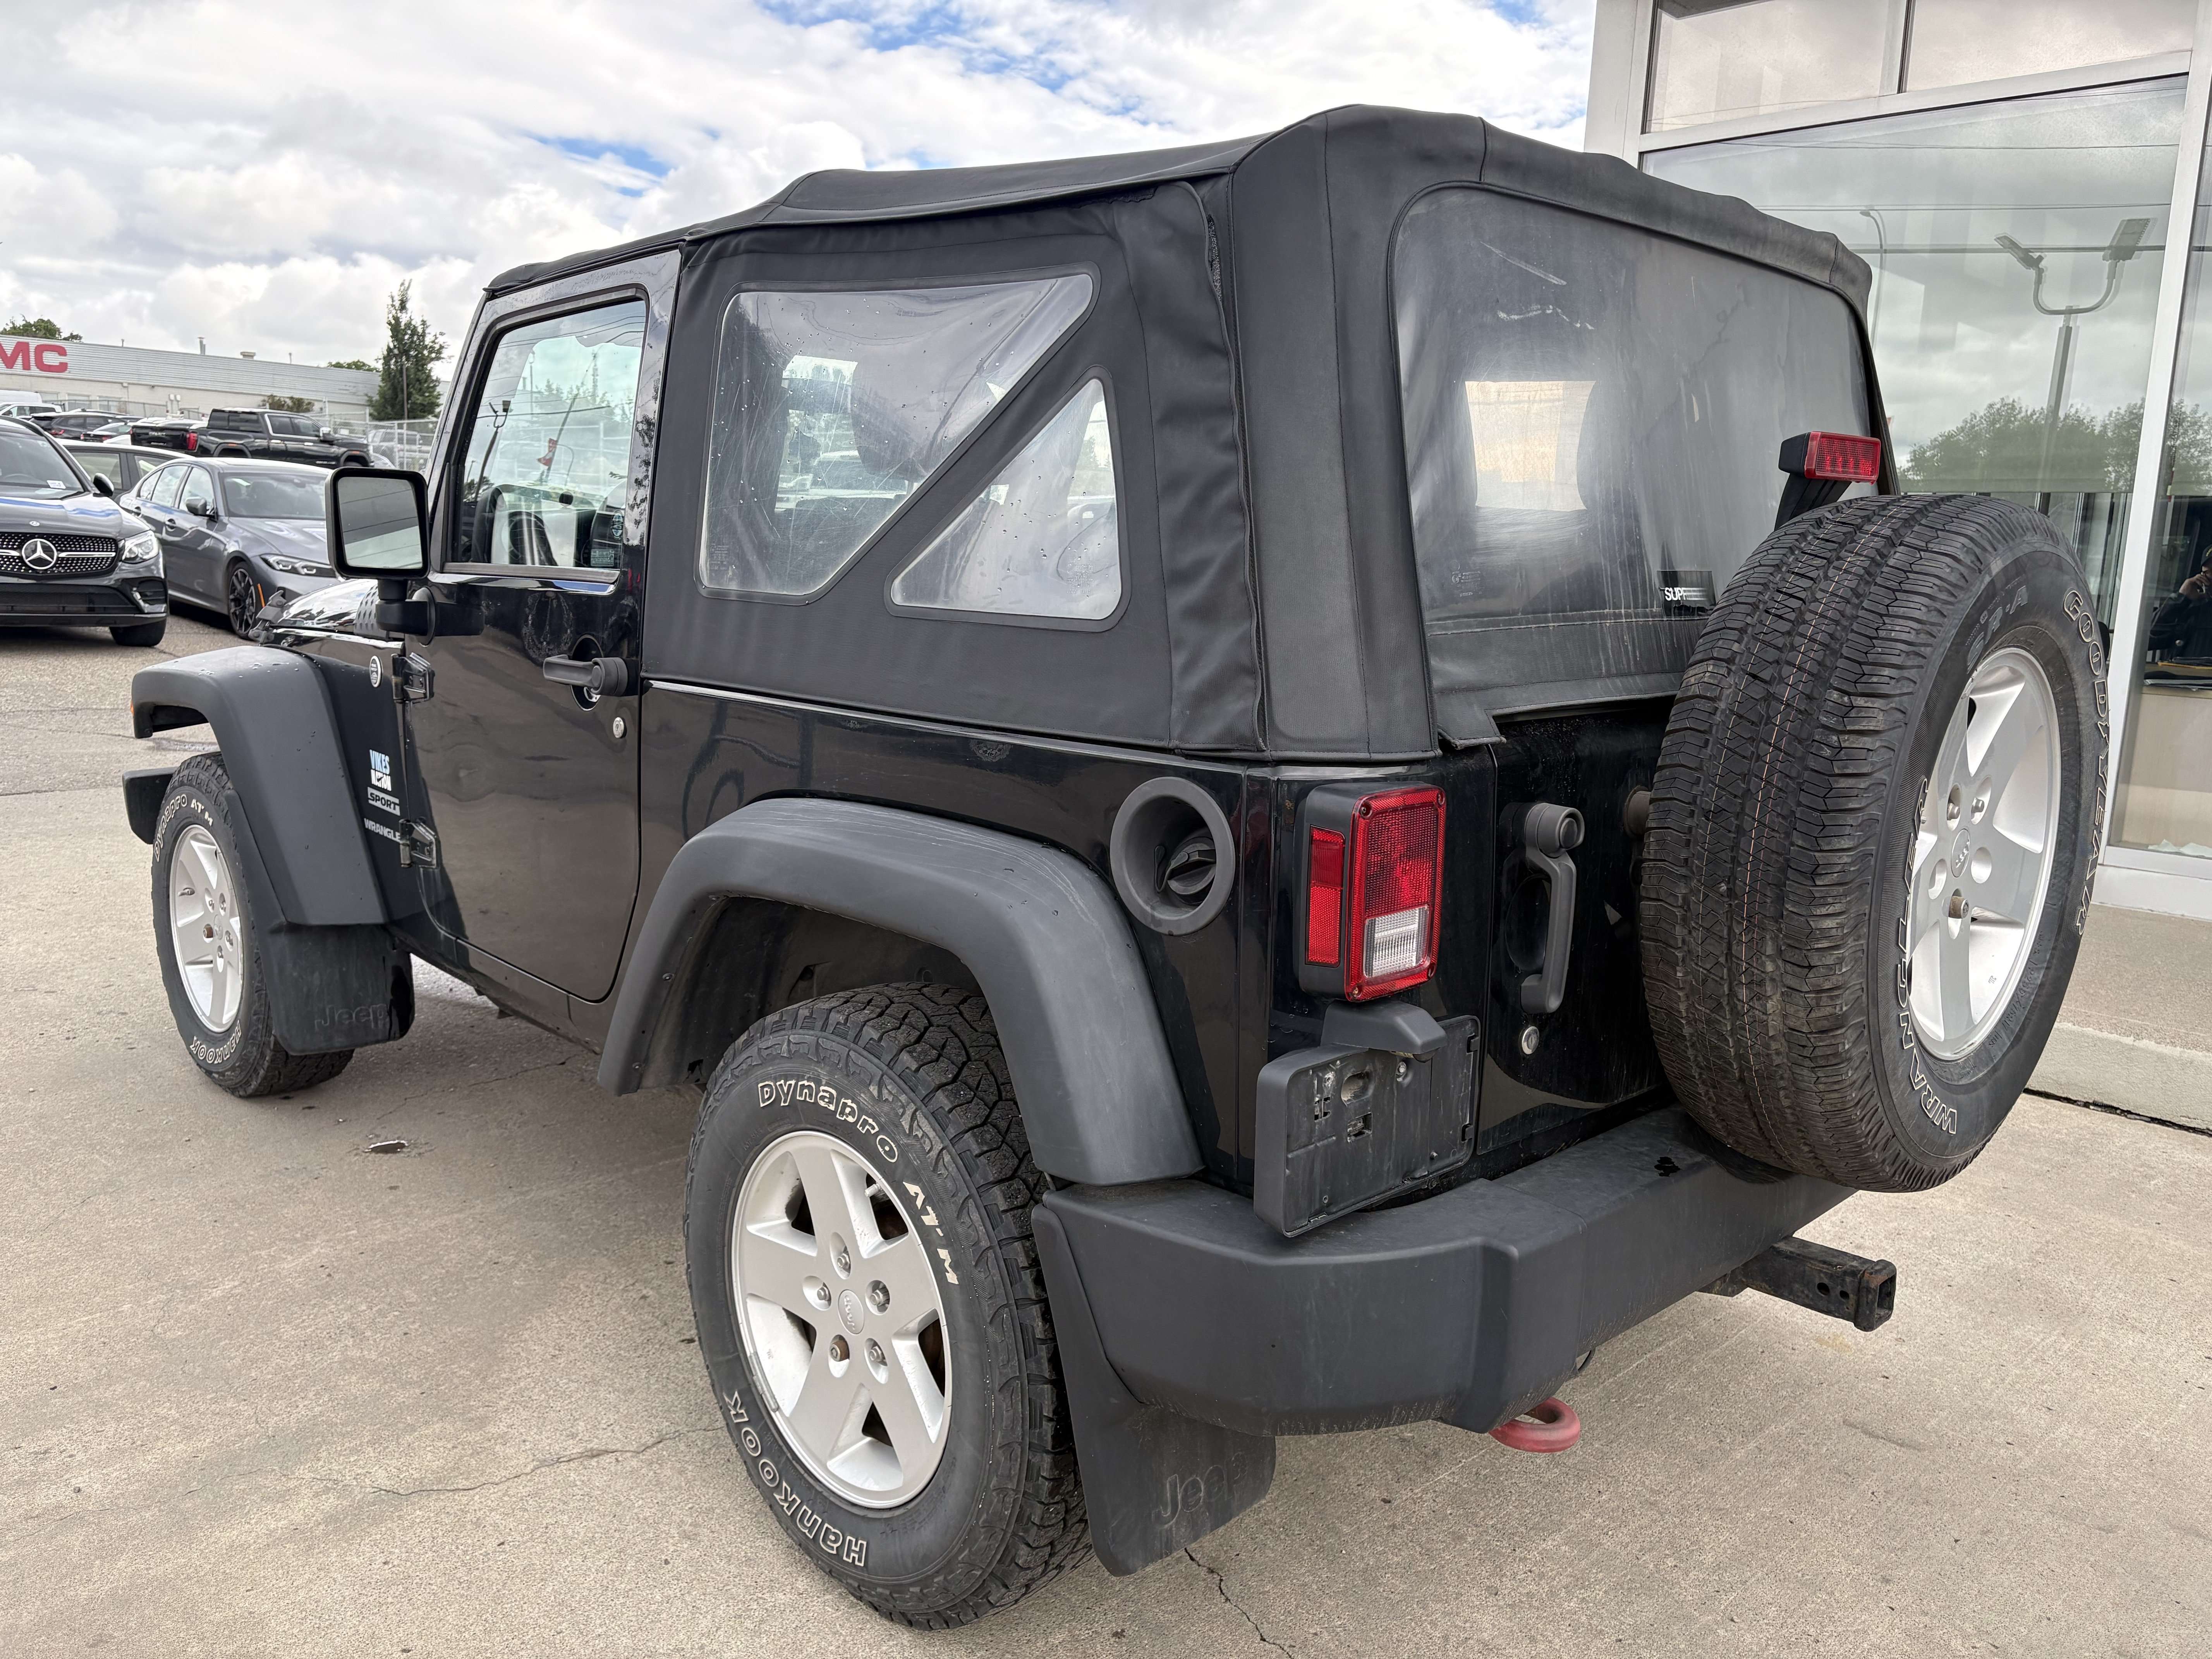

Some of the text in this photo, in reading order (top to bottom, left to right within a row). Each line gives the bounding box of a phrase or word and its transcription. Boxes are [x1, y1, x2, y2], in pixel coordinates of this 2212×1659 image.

[369, 749, 390, 774] VIKES
[2064, 591, 2109, 934] GOODYEAR
[371, 769, 392, 791] NATION
[369, 792, 400, 811] SPORT
[364, 818, 401, 843] WRANGLE
[1898, 778, 1956, 1134] WRANGLER
[314, 1004, 387, 1031] Jeep
[844, 1295, 855, 1330] Jeep
[1152, 1451, 1247, 1528] Jeep
